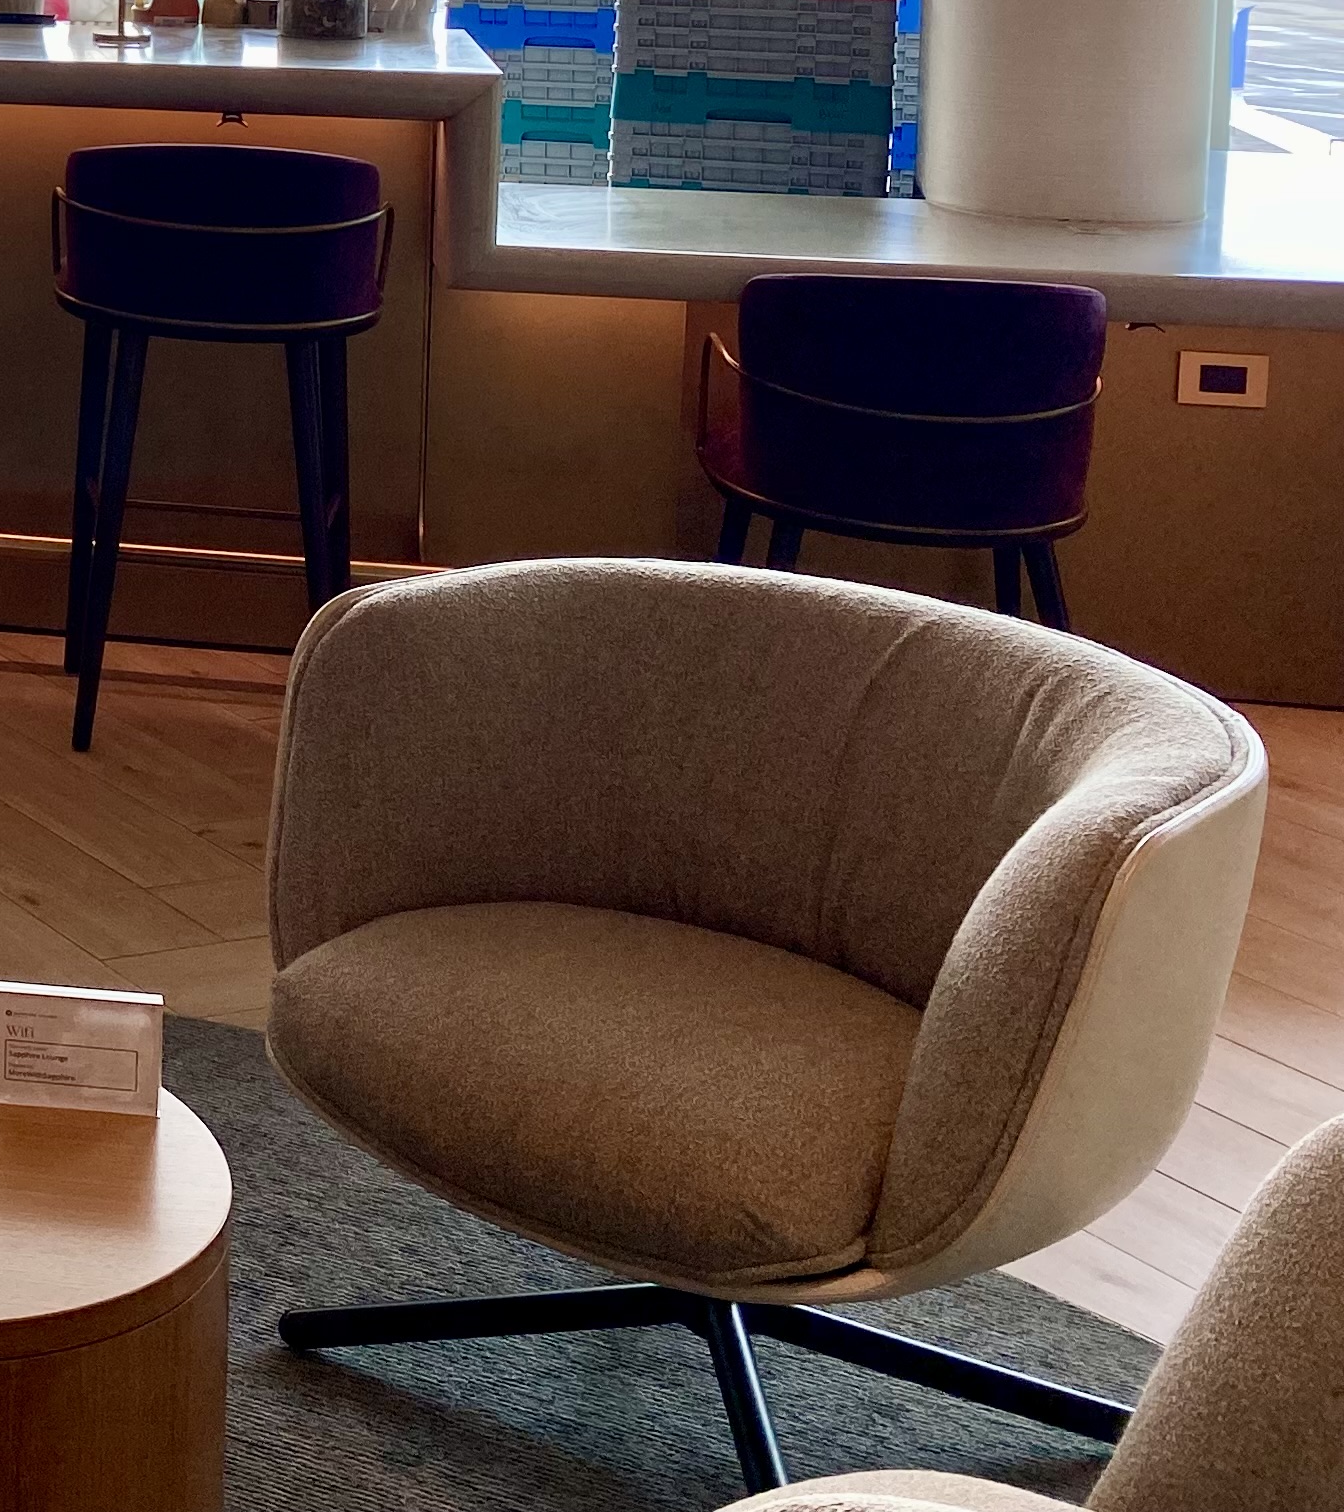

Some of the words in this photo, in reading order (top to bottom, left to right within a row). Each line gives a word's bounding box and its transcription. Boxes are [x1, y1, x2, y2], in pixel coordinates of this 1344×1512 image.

[6, 1024, 34, 1039] Wifi
[8, 1050, 40, 1061] Sapphire
[42, 1054, 69, 1063] Lounge
